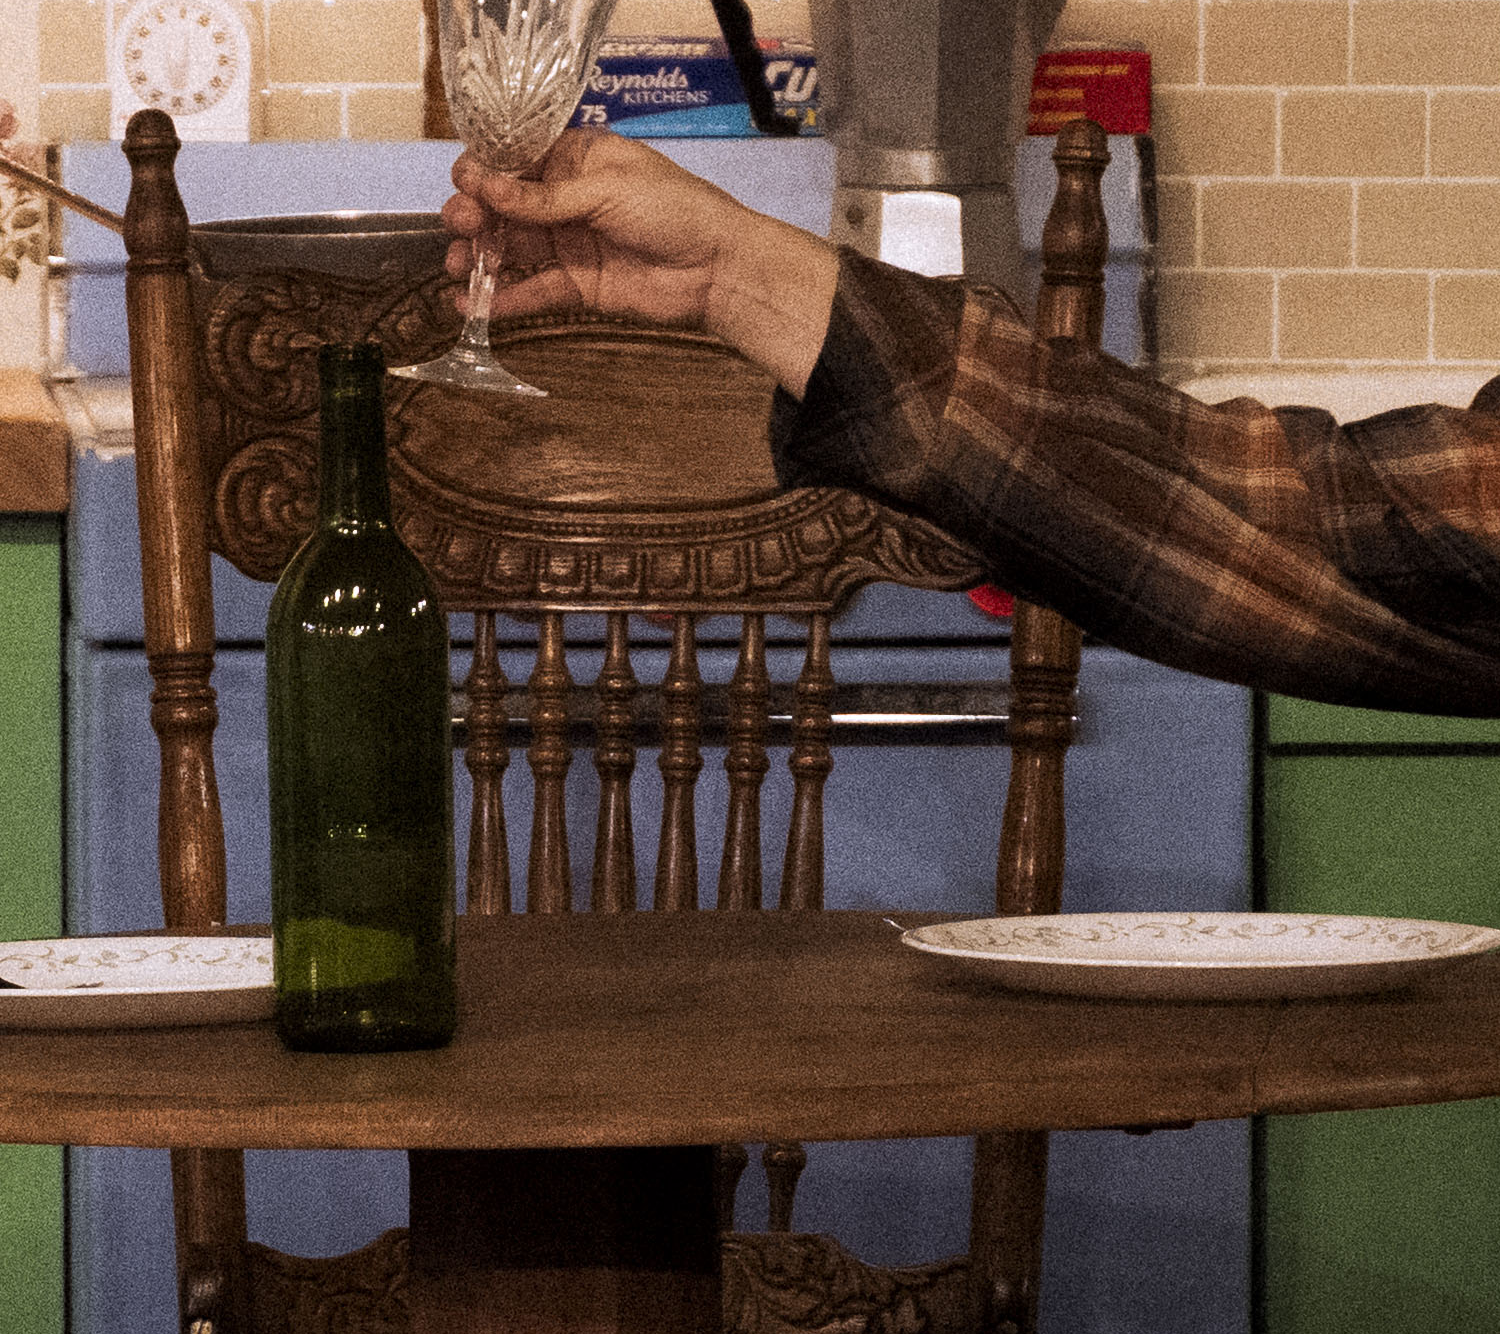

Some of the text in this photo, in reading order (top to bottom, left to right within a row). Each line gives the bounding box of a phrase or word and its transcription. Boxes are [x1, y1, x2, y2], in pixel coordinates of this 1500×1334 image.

[584, 64, 689, 96] Reynolds
[764, 60, 819, 103] CU
[622, 90, 709, 105] KITCHENS
[579, 104, 608, 123] 75
